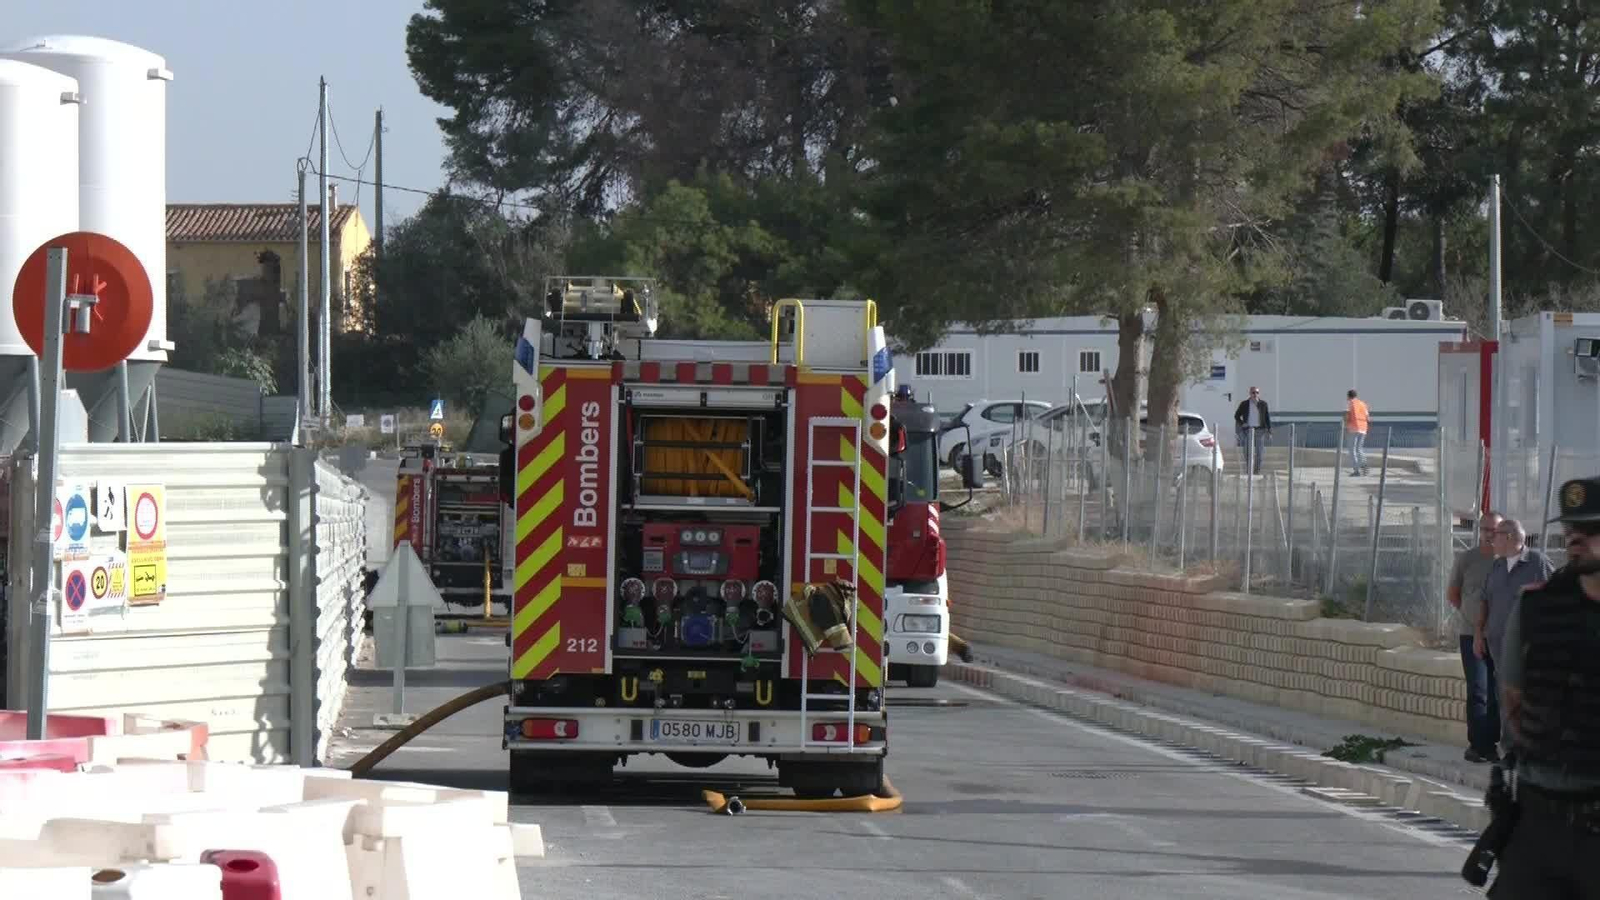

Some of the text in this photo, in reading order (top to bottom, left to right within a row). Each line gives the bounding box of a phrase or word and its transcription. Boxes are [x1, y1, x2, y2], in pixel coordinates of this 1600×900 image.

[573, 401, 600, 527] Bombers
[95, 576, 105, 590] 20
[567, 638, 598, 653] 212
[662, 722, 735, 739] 0580 MJB
